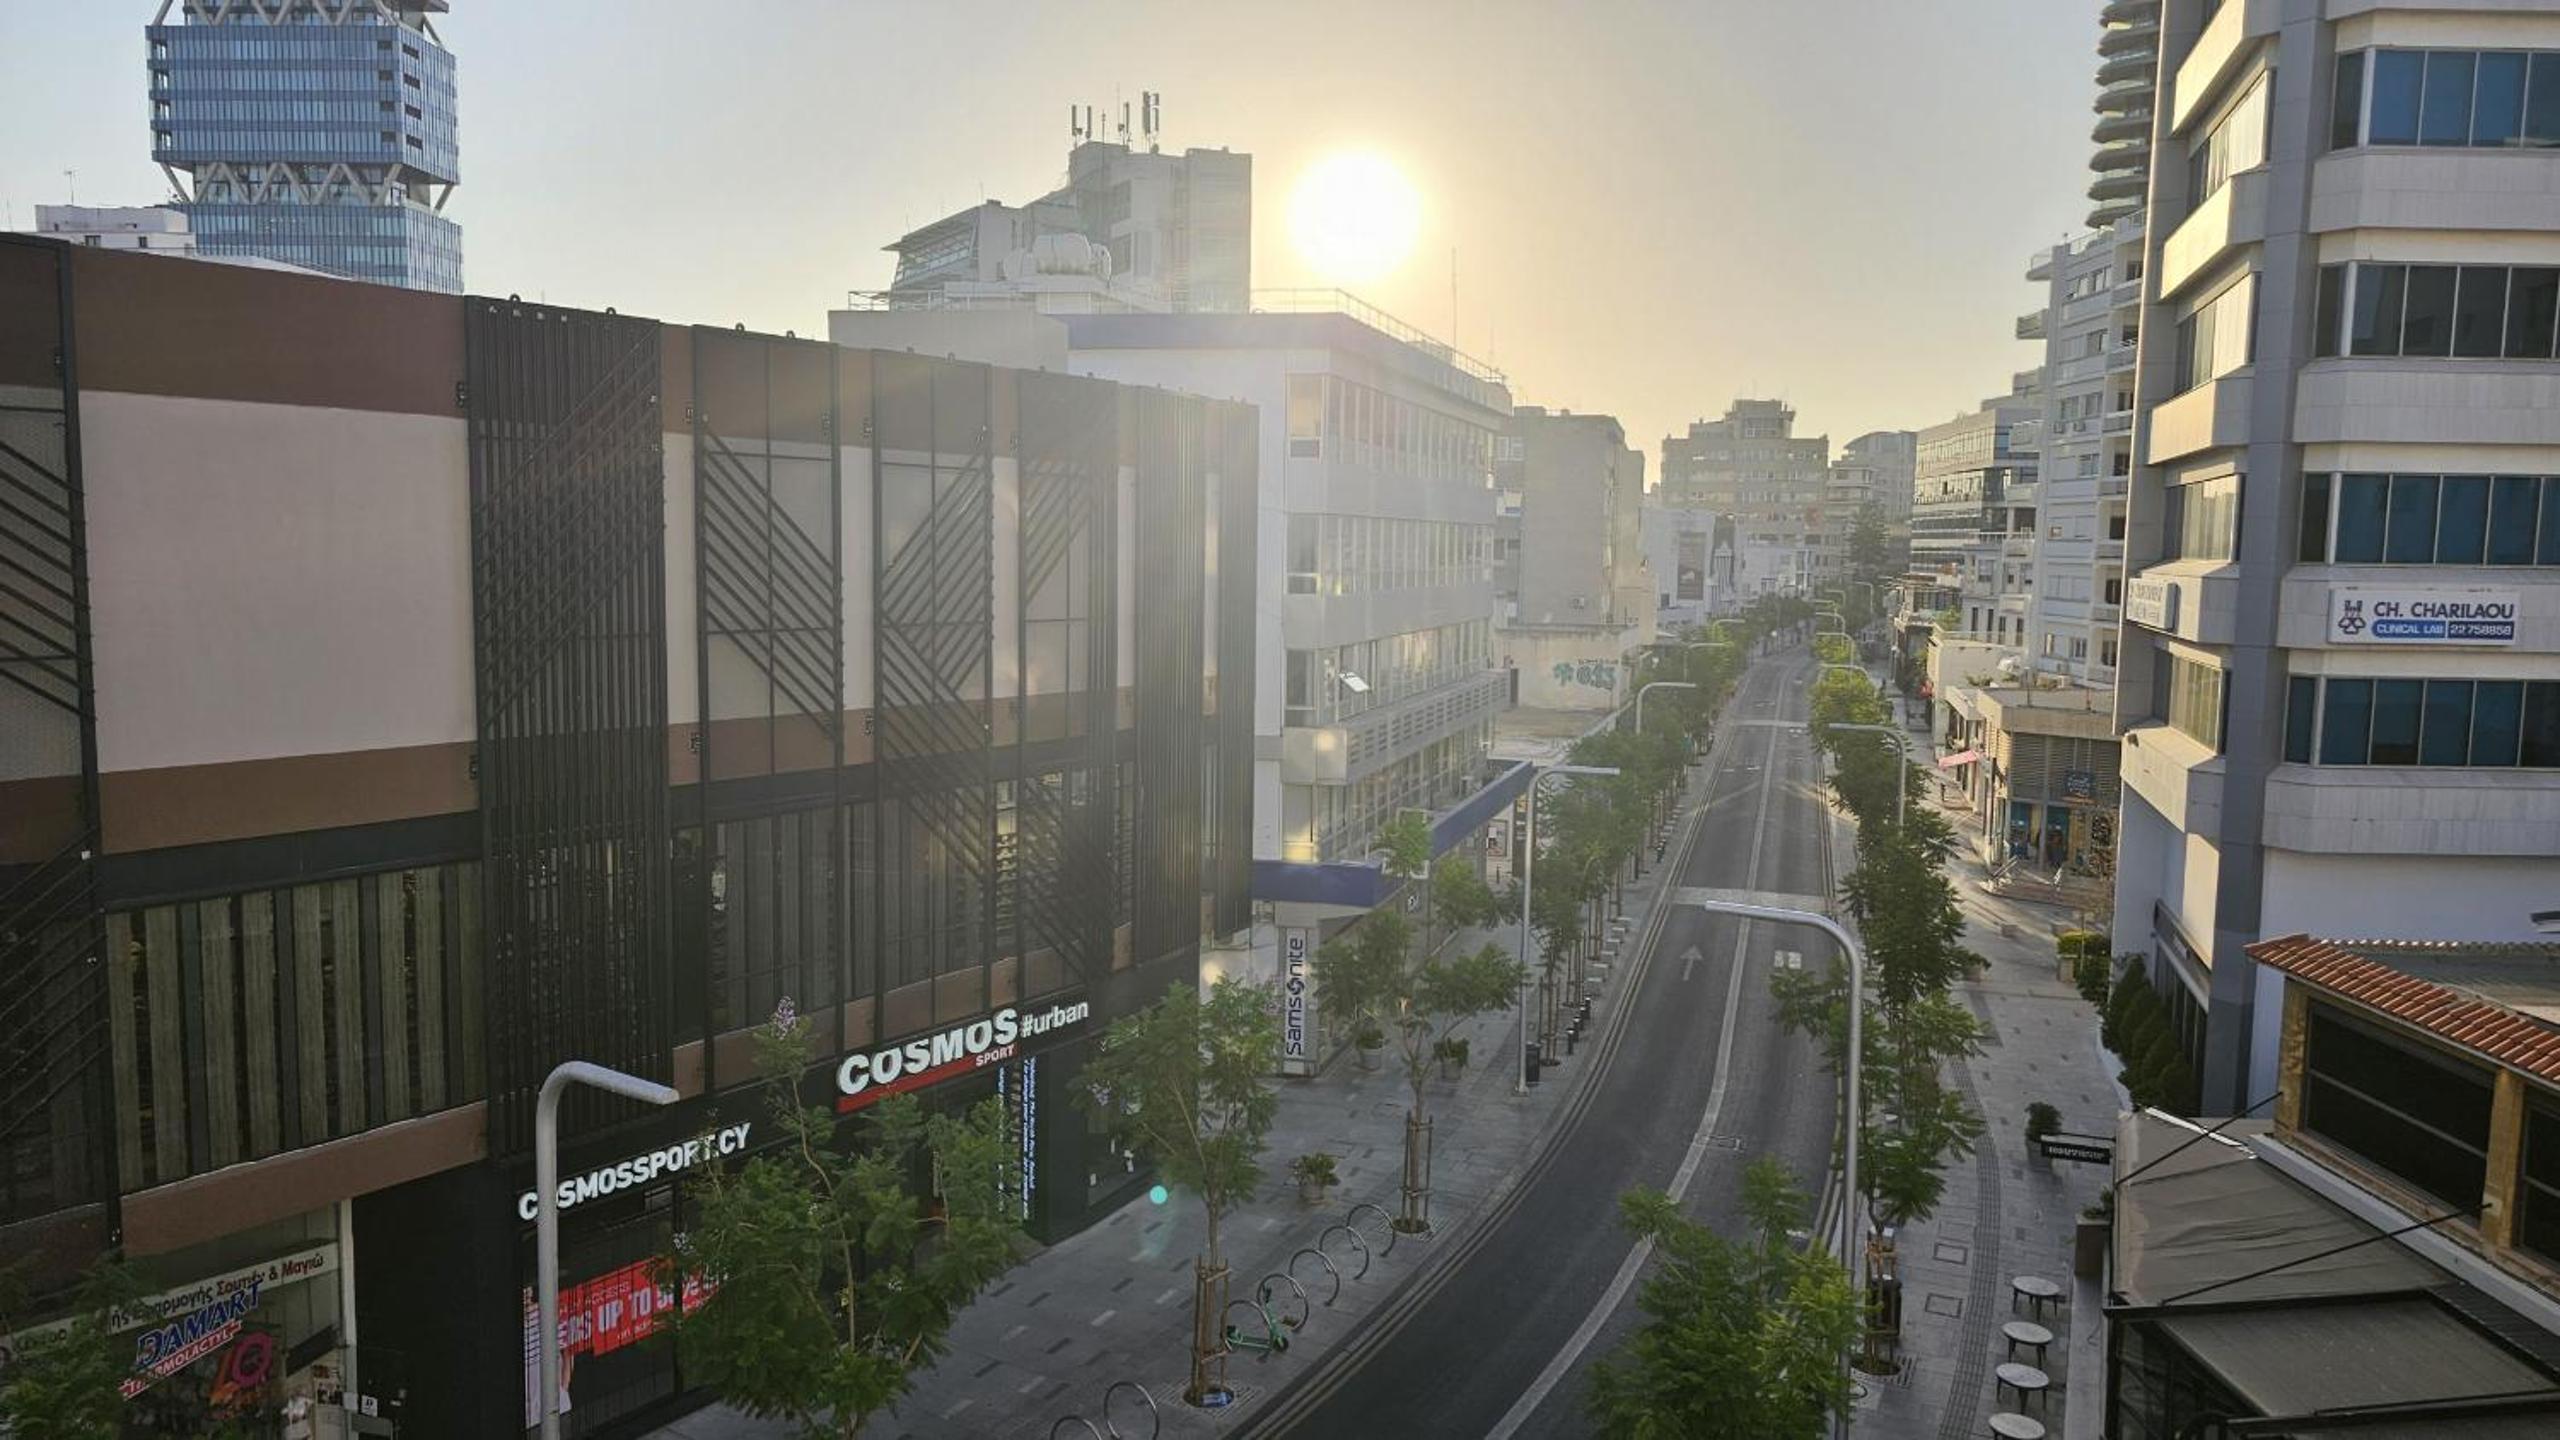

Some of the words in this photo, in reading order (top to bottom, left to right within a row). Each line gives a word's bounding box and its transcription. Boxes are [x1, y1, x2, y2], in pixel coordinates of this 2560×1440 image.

[2374, 601, 2404, 617] CH.
[2411, 602, 2515, 619] CHARILAOU
[2376, 624, 2420, 634] CLINICAL
[2423, 625, 2444, 635] LAB
[837, 1008, 1018, 1095] COSMOS
[1020, 999, 1088, 1037] #urban
[975, 1044, 1016, 1068] SPORT
[518, 1122, 752, 1221] CSMOSSPORT.CY
[269, 1266, 278, 1281] &
[135, 1278, 263, 1371] DAMART
[598, 1299, 623, 1333] UP
[629, 1286, 652, 1320] TO
[128, 1328, 232, 1394] TRMOLACTYL
